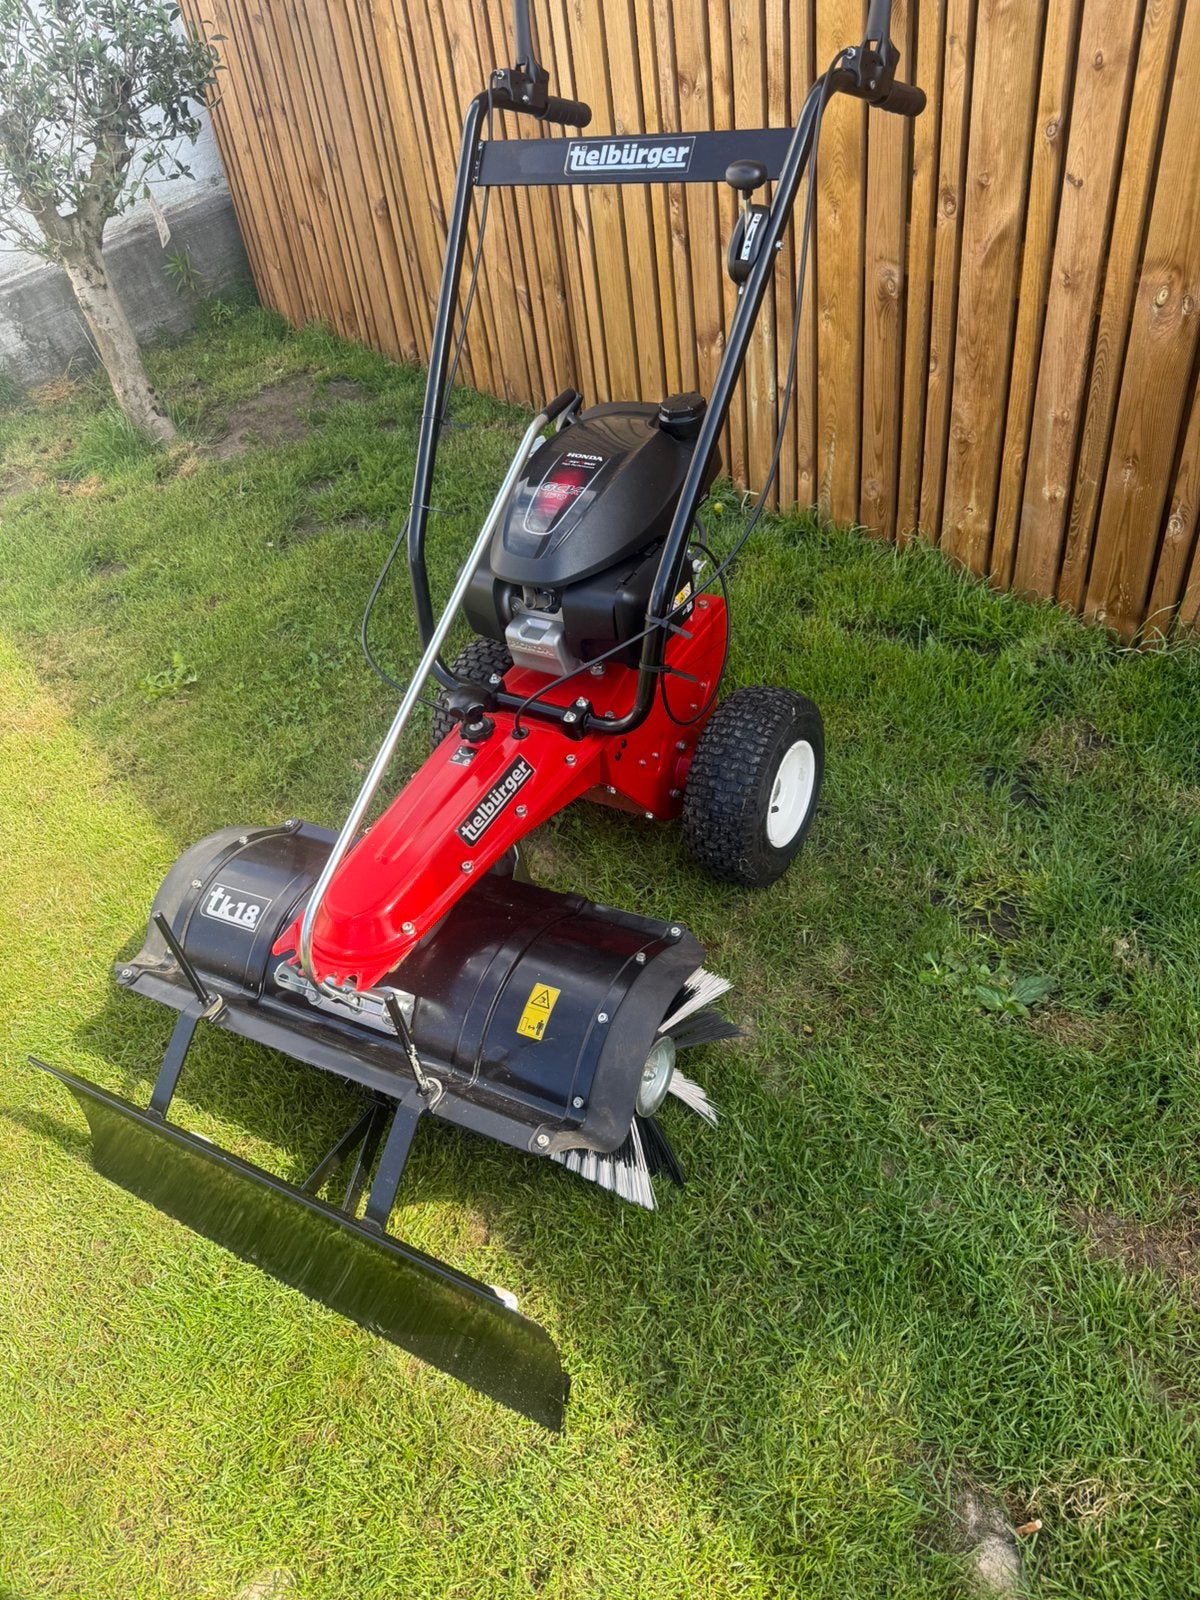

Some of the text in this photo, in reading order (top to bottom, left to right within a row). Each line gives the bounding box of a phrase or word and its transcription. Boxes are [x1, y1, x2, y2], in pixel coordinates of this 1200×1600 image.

[570, 144, 690, 171] tielbürger
[566, 452, 603, 462] HONDA
[461, 760, 532, 841] tielbürger
[206, 887, 260, 929] tk18
